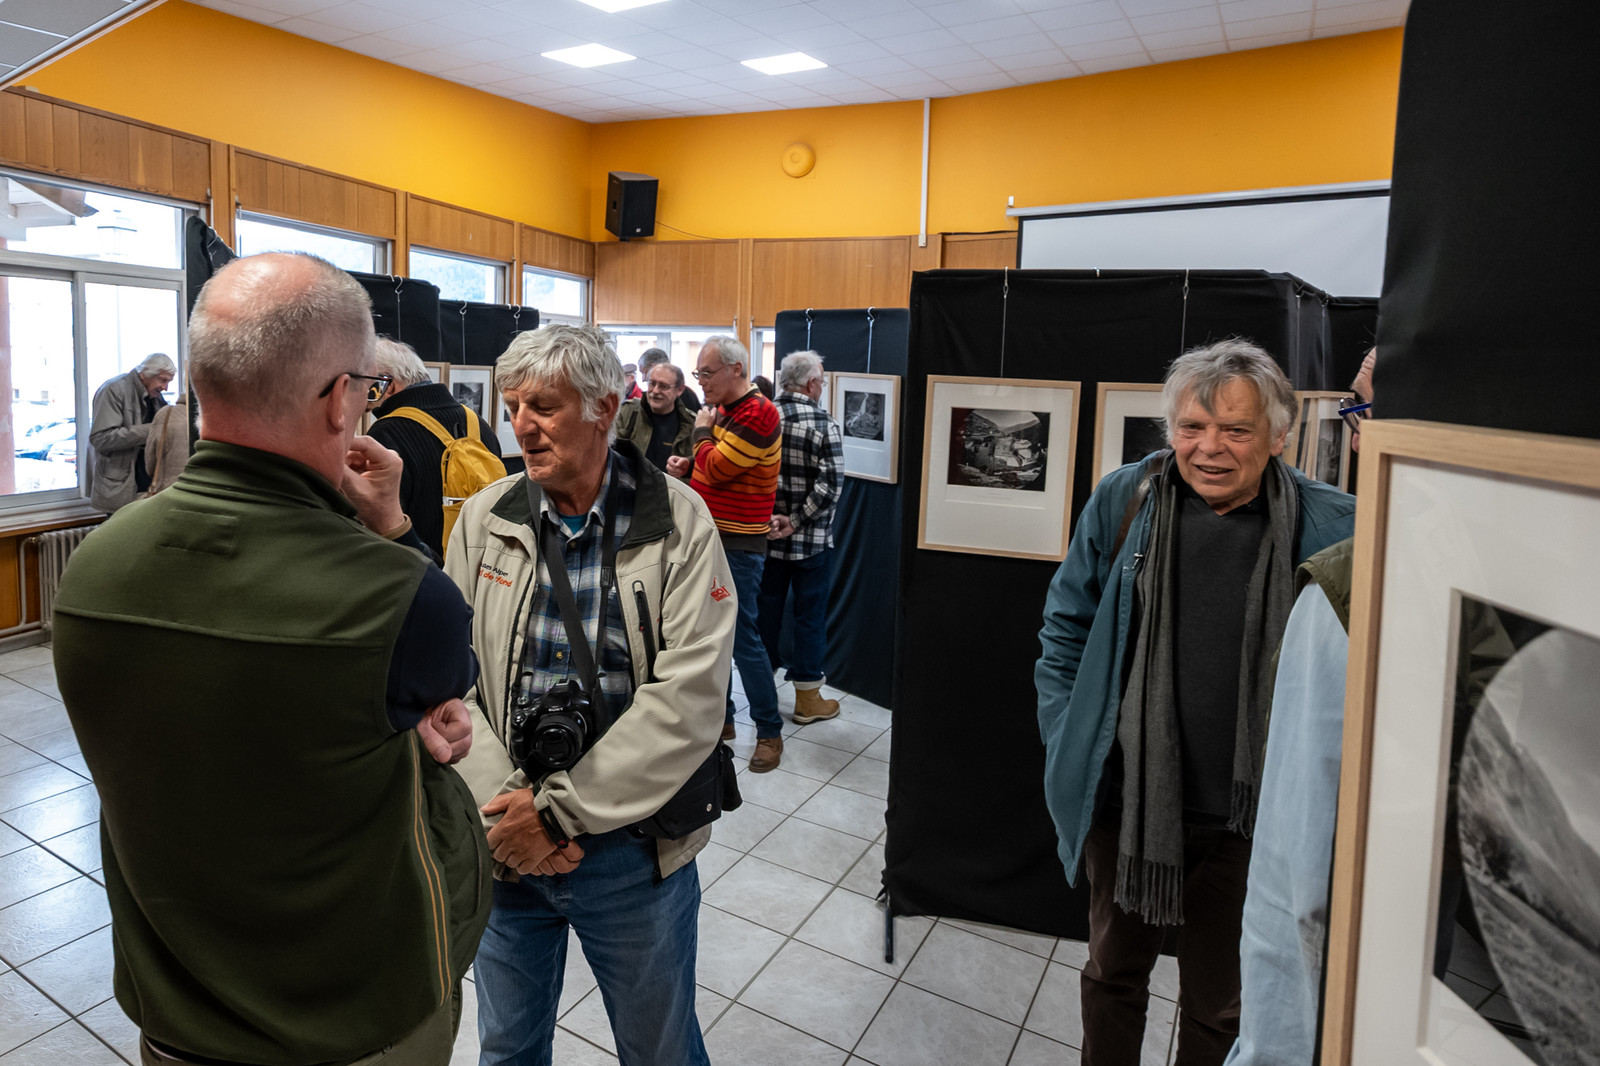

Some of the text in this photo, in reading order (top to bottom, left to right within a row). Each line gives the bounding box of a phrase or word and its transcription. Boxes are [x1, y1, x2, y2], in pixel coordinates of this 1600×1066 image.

[493, 567, 508, 576] Alpe
[483, 571, 494, 580] de
[495, 576, 513, 587] fond
